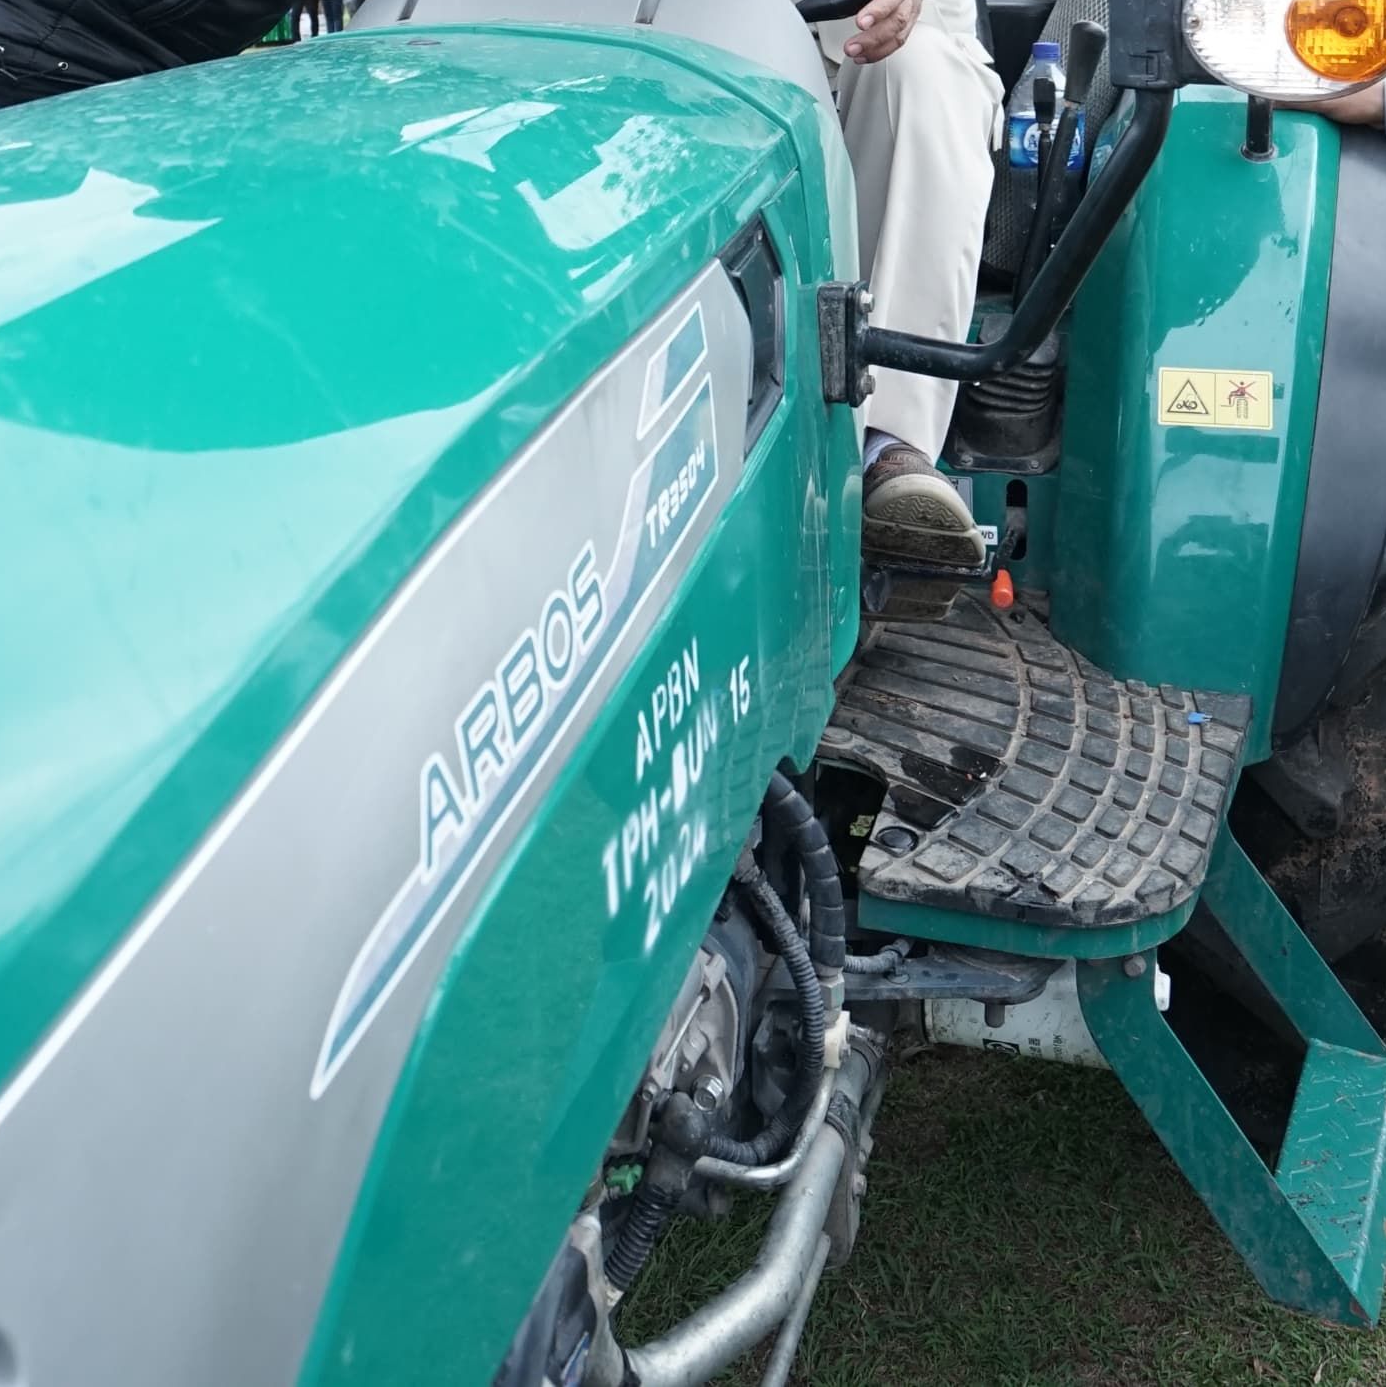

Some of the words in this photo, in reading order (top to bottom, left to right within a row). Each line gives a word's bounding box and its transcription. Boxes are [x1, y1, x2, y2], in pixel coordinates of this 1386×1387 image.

[645, 439, 706, 549] TR3504
[420, 539, 606, 886] ARBOS
[636, 636, 700, 785] APBN
[729, 655, 751, 724] 15
[643, 816, 707, 956] 2024
